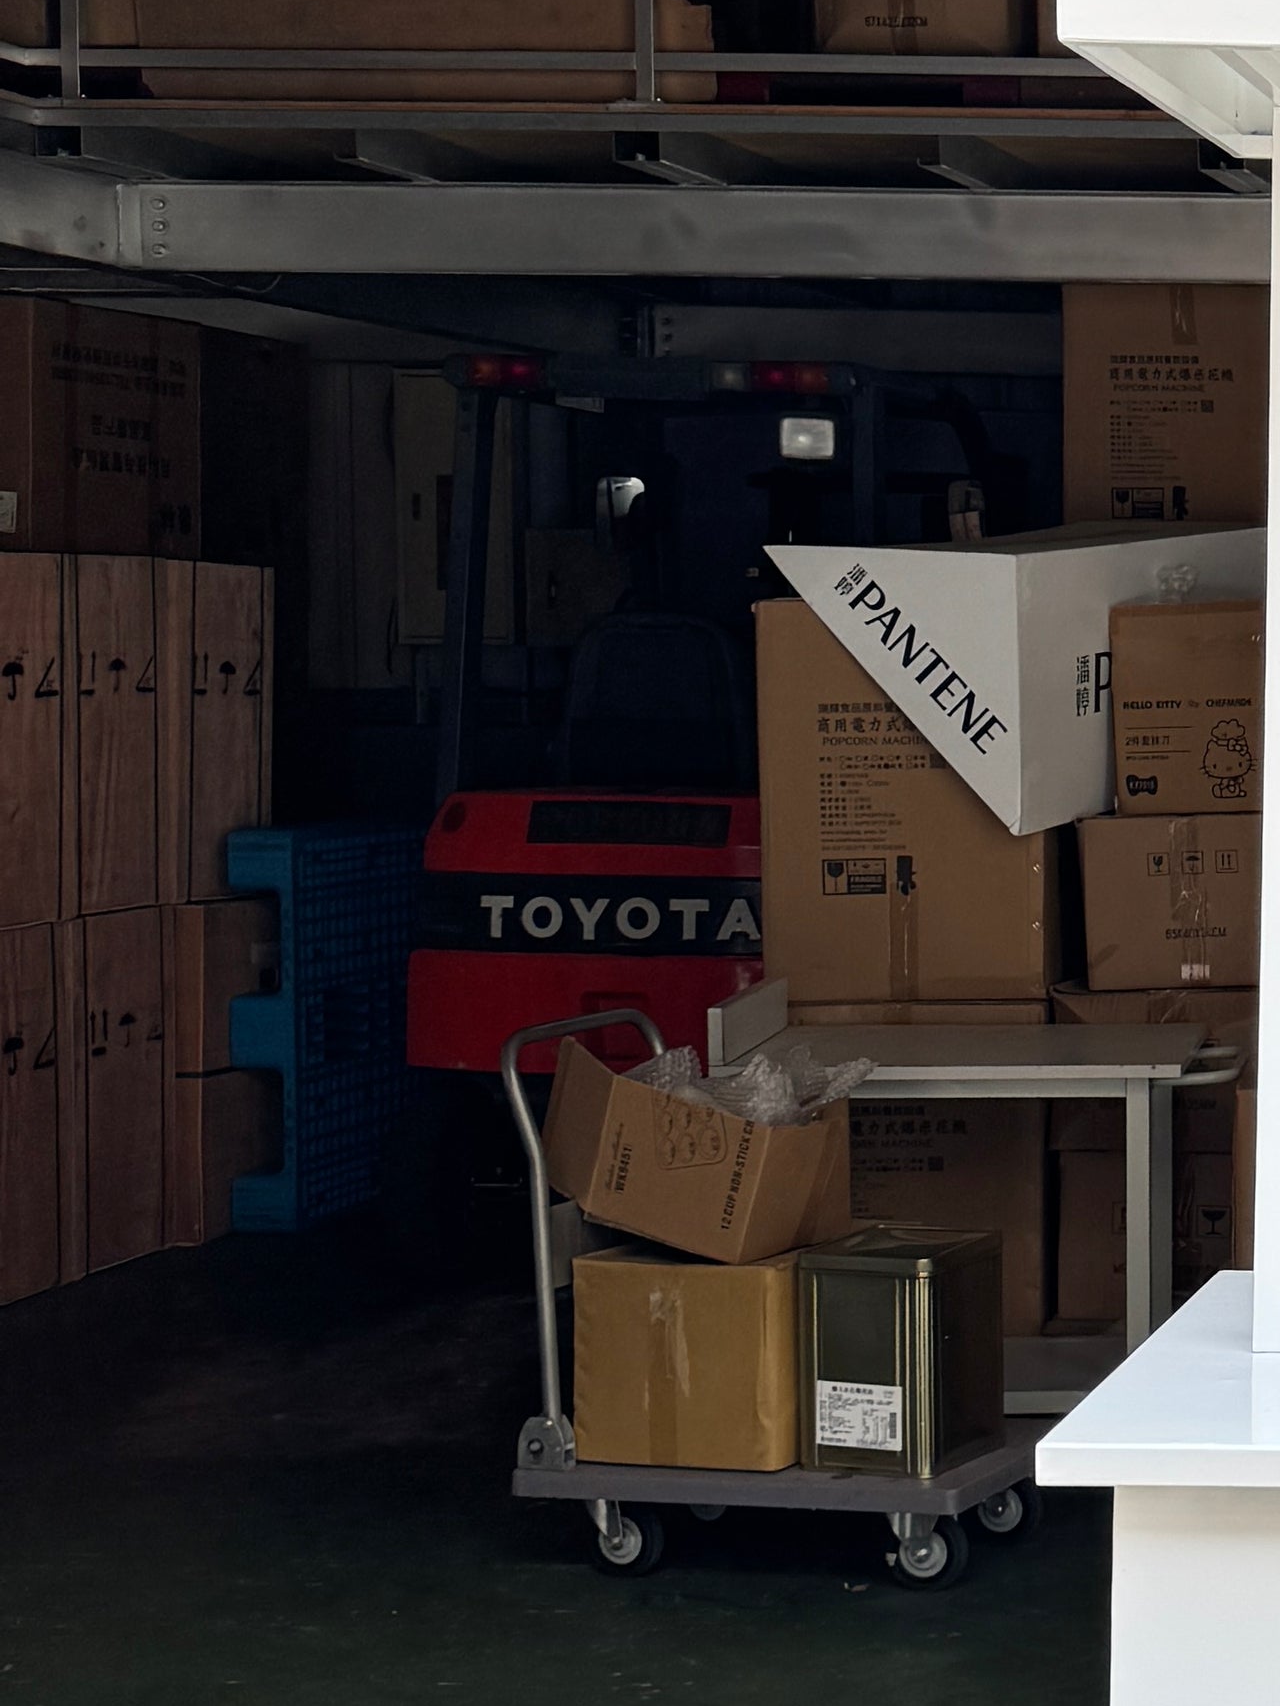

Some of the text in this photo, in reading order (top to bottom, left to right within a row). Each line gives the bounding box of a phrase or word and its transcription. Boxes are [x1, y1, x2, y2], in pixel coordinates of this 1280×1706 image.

[848, 580, 1008, 755] PANTENE
[1123, 701, 1152, 709] HELLO
[1156, 700, 1182, 709] KITTY
[823, 737, 877, 746] POPCORN
[480, 895, 761, 941] TOYOTA
